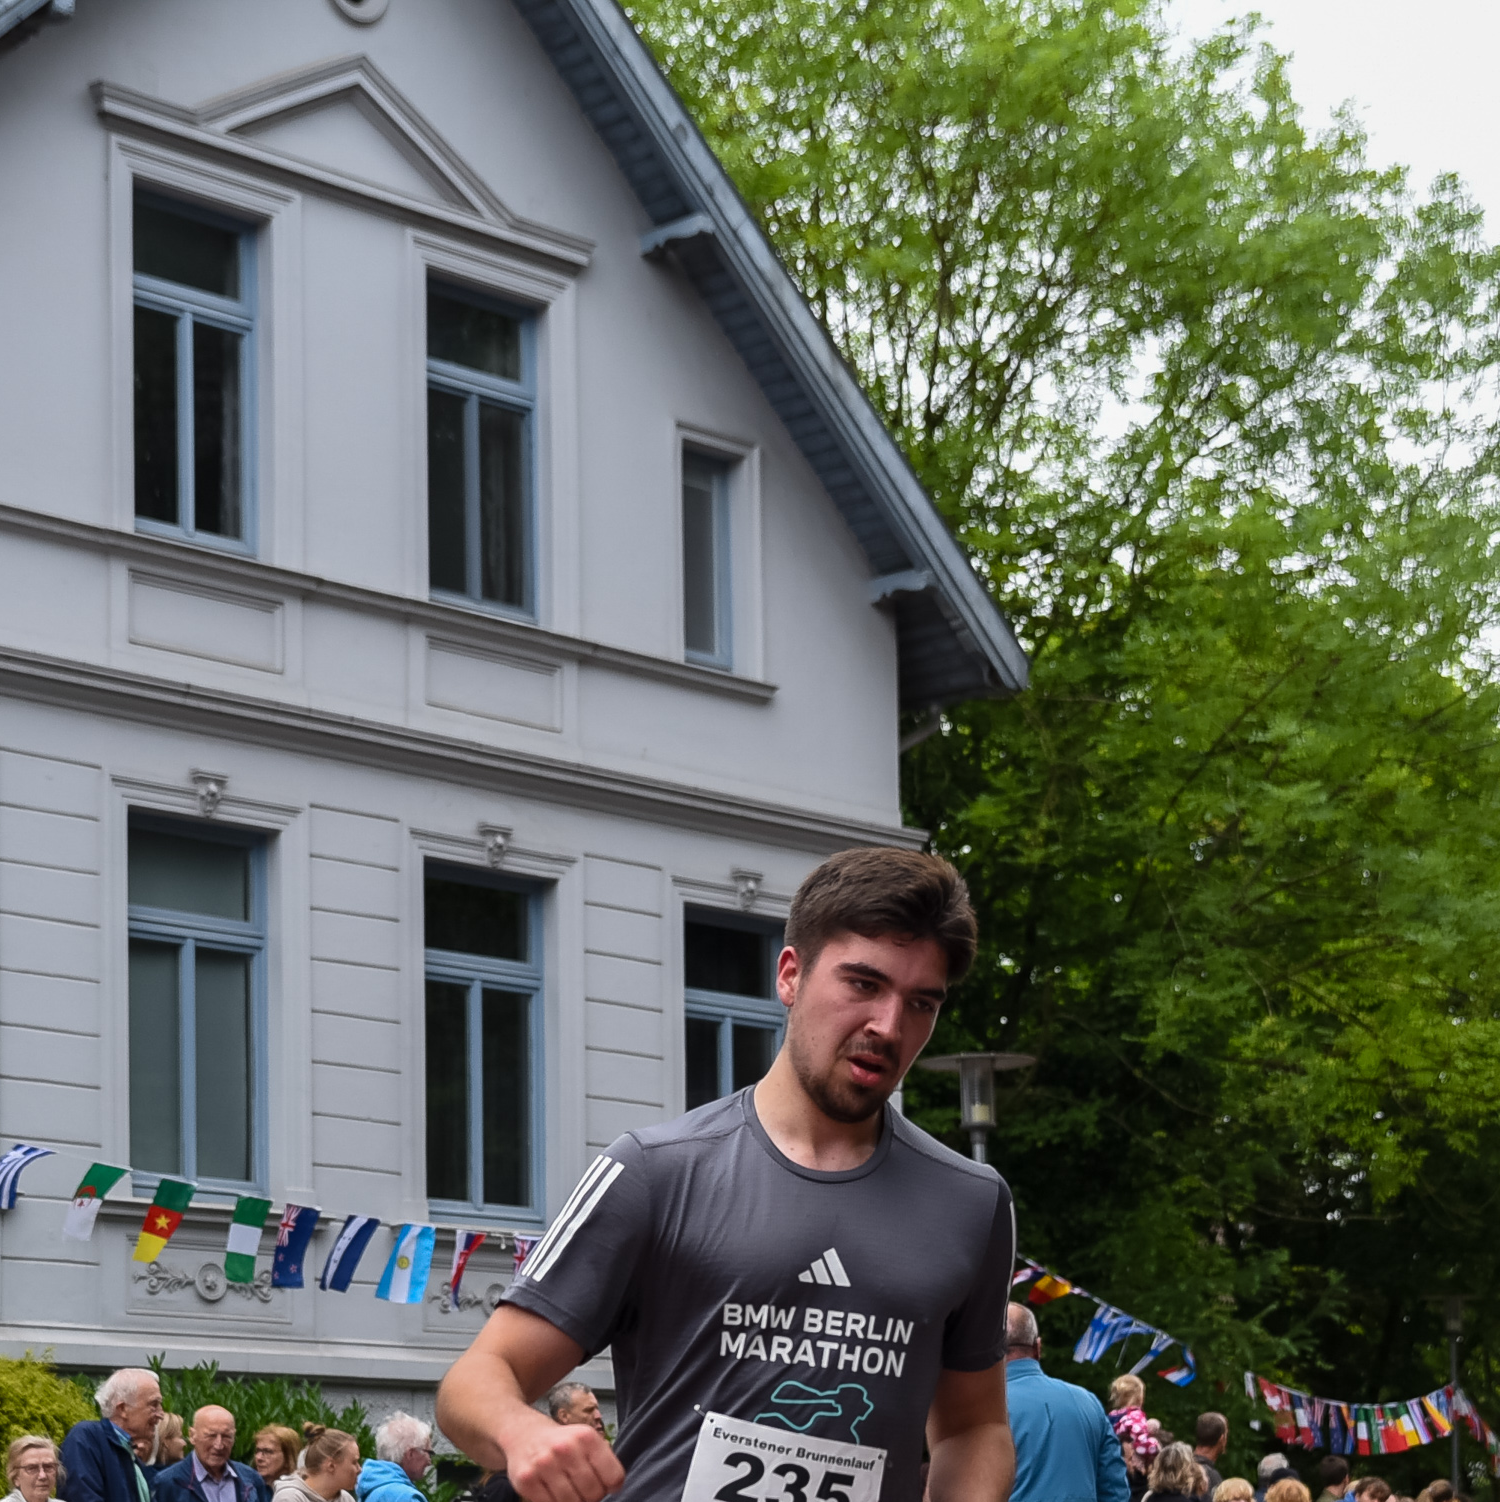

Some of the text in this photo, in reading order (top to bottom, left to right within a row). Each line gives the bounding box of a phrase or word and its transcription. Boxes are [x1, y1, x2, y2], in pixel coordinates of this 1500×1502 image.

[723, 1303, 914, 1345] BMW BERLIN
[719, 1331, 906, 1378] MARATHON
[713, 1427, 875, 1472] Everstener Brunnenlauf
